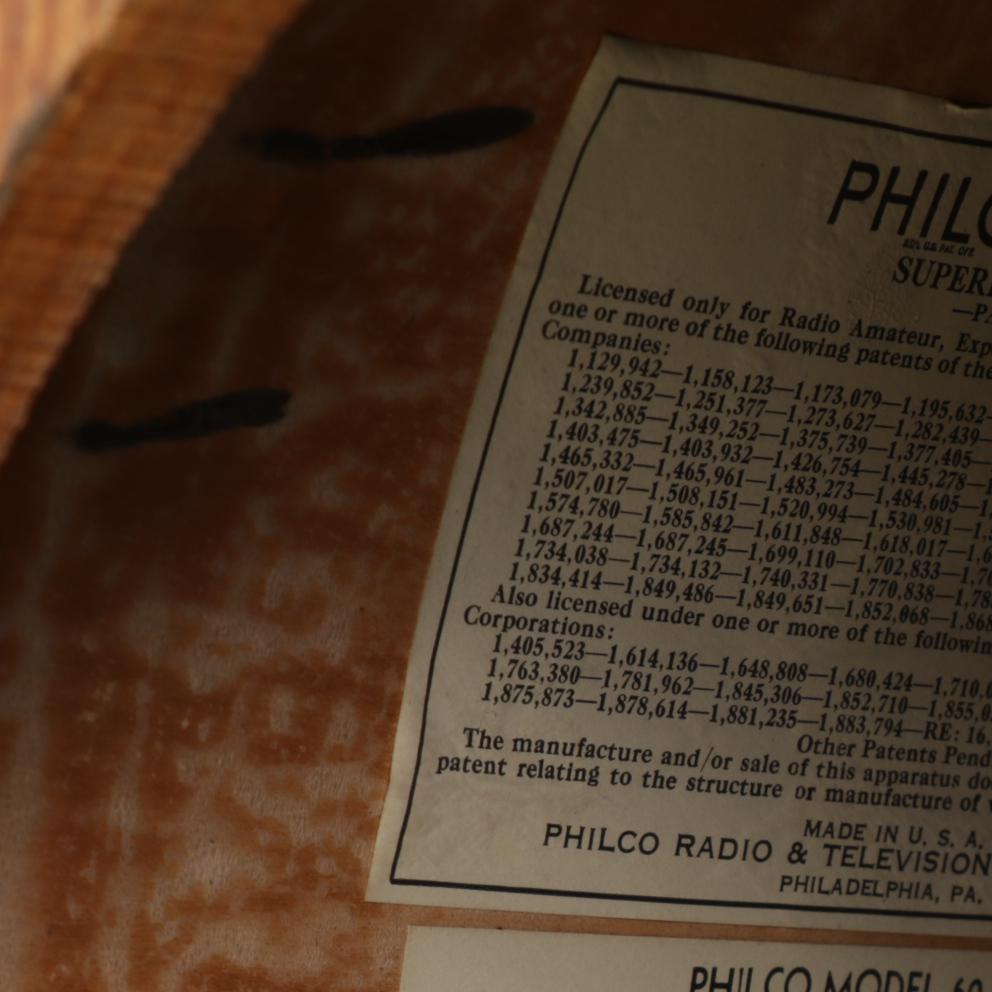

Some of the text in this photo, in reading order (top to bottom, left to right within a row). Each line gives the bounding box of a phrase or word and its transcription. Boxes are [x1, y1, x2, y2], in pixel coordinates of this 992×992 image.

[540, 318, 671, 356] Companies:
[547, 299, 588, 319] one
[593, 306, 618, 323] or
[622, 311, 680, 333] more
[683, 318, 711, 339] of
[711, 321, 749, 345] the
[753, 327, 851, 363] following
[853, 347, 933, 372] patents
[936, 355, 961, 375] of
[576, 272, 676, 308] Licensed
[681, 294, 731, 320] only
[738, 299, 771, 324] for
[778, 305, 841, 334] Radio
[848, 317, 944, 352] Amateur,
[462, 603, 615, 640] Corporations:
[489, 583, 538, 607] Also
[545, 589, 634, 619] licensed
[640, 604, 705, 627] under
[710, 612, 750, 632] one
[755, 617, 780, 635] or
[785, 621, 840, 640] more
[845, 622, 869, 643] of
[873, 626, 908, 647] the
[461, 725, 505, 751] The
[510, 736, 653, 764] manufacture
[659, 745, 734, 771] and/or
[738, 752, 781, 775] sale
[786, 757, 810, 777] of
[815, 760, 856, 780] this
[862, 767, 960, 788] apparatus
[795, 733, 857, 758] Other
[860, 737, 937, 764] Patents
[434, 754, 508, 777] patent
[515, 758, 600, 787] relating
[609, 767, 632, 786] to
[641, 768, 678, 791] the
[684, 775, 783, 799] structure
[793, 784, 817, 802] or
[823, 787, 953, 811] manufacture
[958, 792, 982, 813] of
[541, 821, 660, 856] PHILCO
[673, 832, 773, 863] RADIO
[785, 840, 808, 865] &
[822, 842, 992, 877] TELEVISION
[802, 818, 984, 850] MADE IN U. S. A.
[778, 873, 983, 905] PHILADELPHIA, PA.
